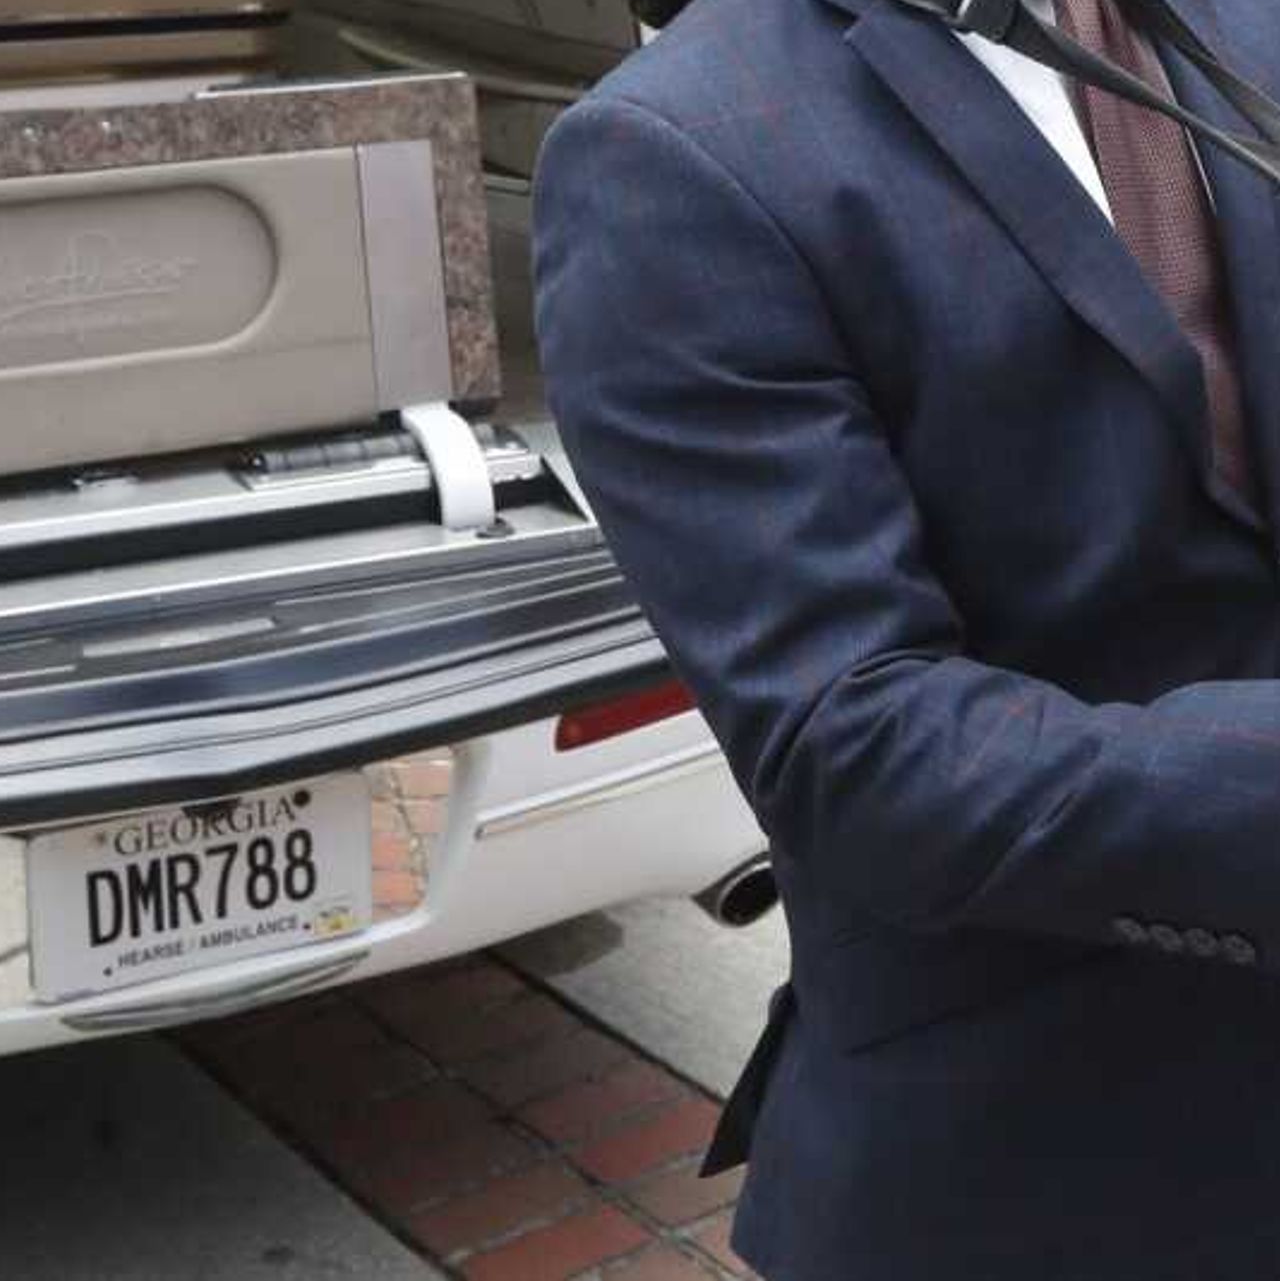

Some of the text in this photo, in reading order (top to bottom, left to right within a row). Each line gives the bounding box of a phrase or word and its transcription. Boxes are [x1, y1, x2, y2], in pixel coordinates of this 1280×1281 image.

[114, 795, 296, 856] GEORGIA
[86, 827, 317, 949] DMR788
[117, 939, 184, 969] HEARSE
[199, 914, 298, 951] AMBULANCE
